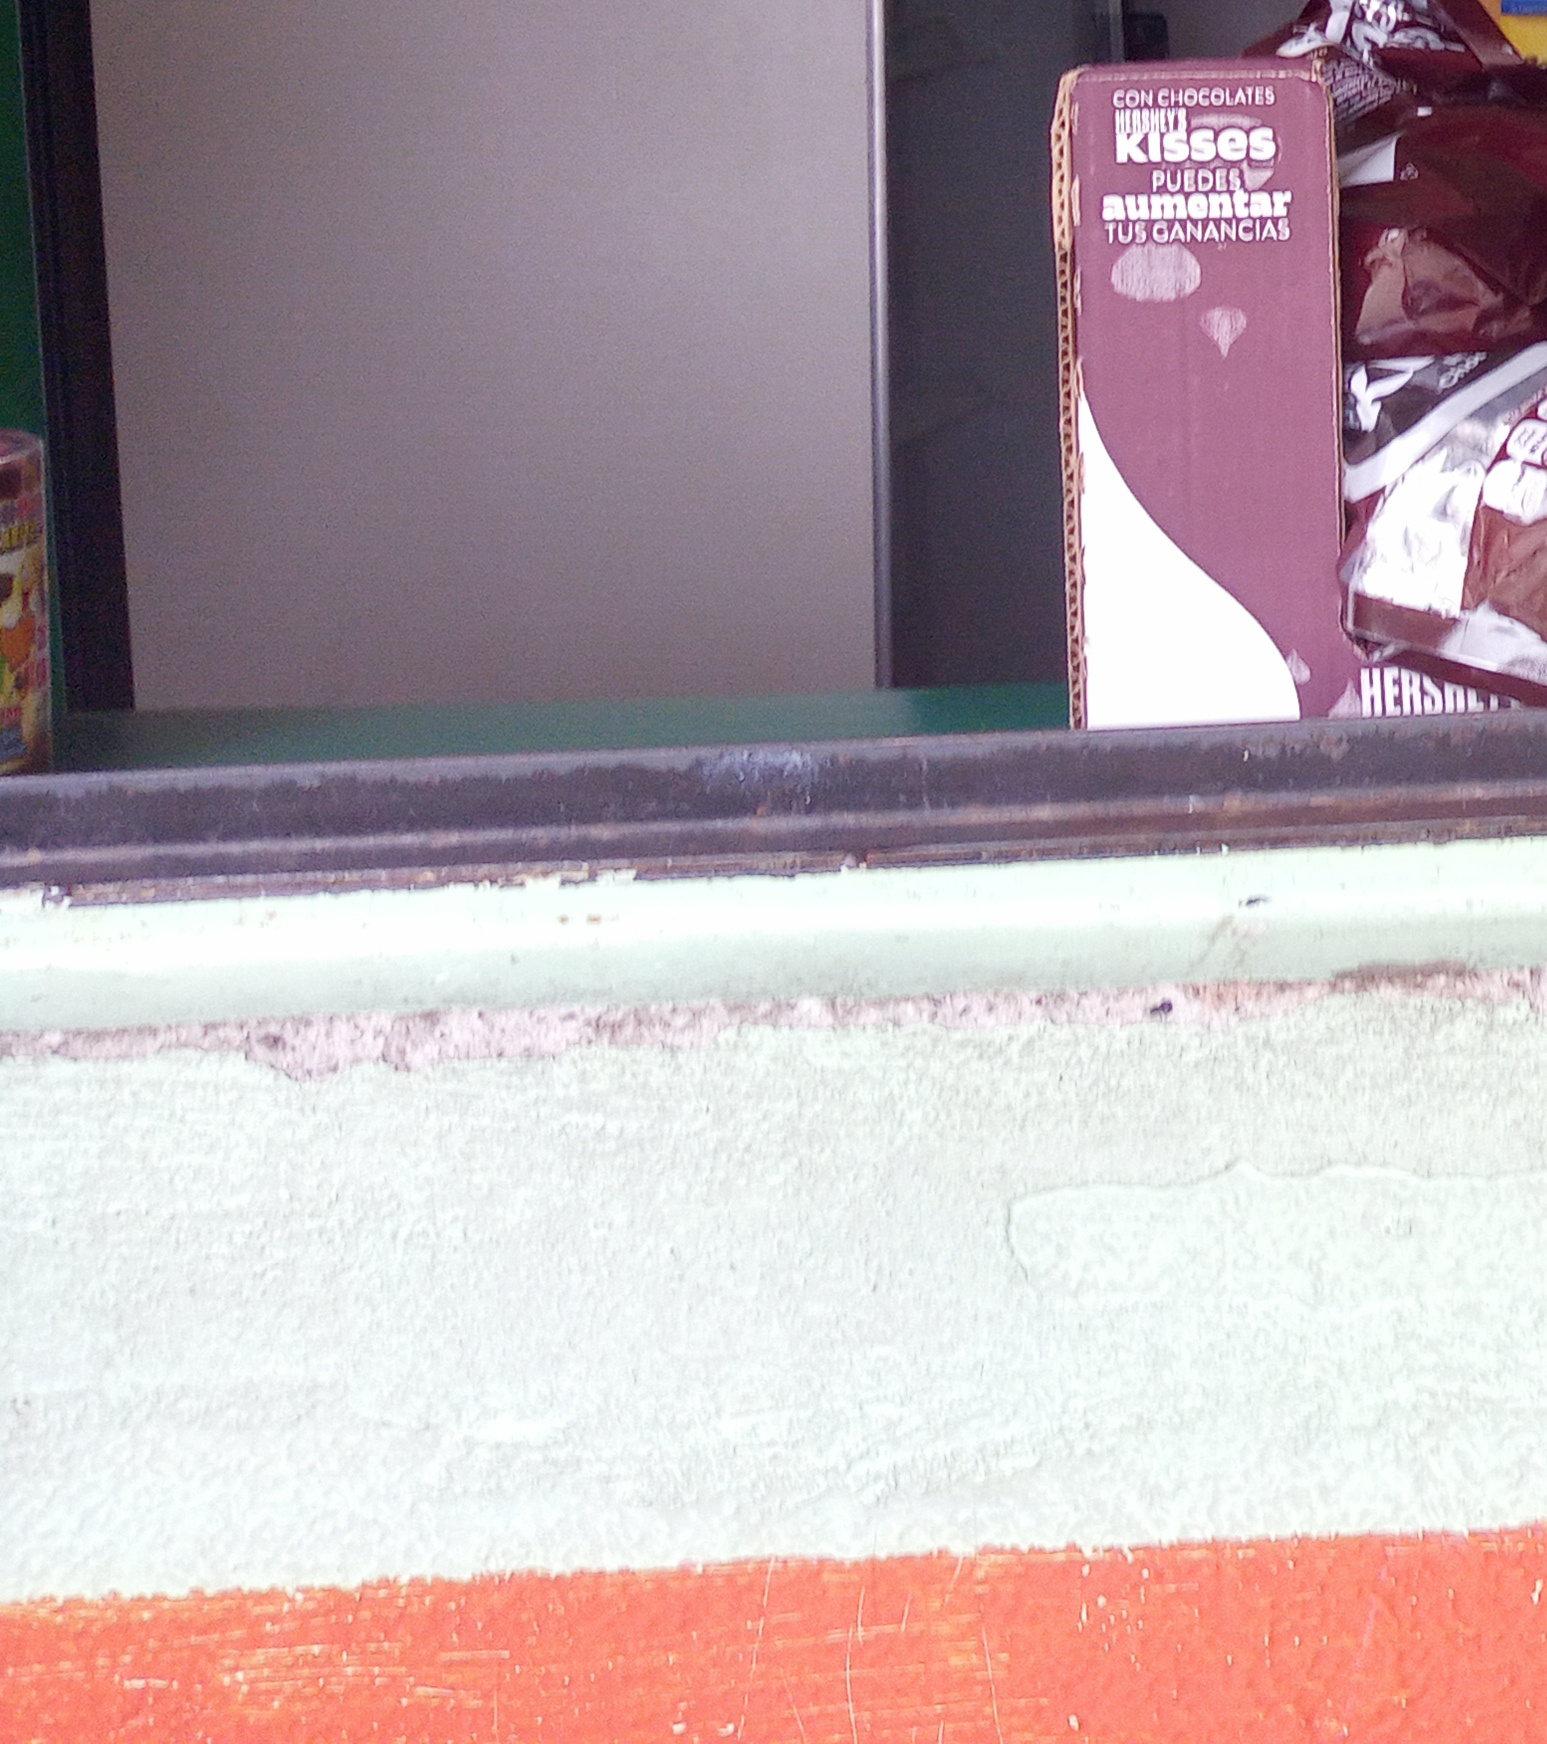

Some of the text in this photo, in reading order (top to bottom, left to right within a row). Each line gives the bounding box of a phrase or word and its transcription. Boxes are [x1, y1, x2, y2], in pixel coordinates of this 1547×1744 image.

[1113, 86, 1276, 108] CON CHOCOLATES
[1115, 108, 1187, 134] HERSHEY'S
[1152, 168, 1241, 193] PUEDES
[1102, 189, 1292, 221] aumentar
[1105, 218, 1291, 244] TUS GANANCIAS
